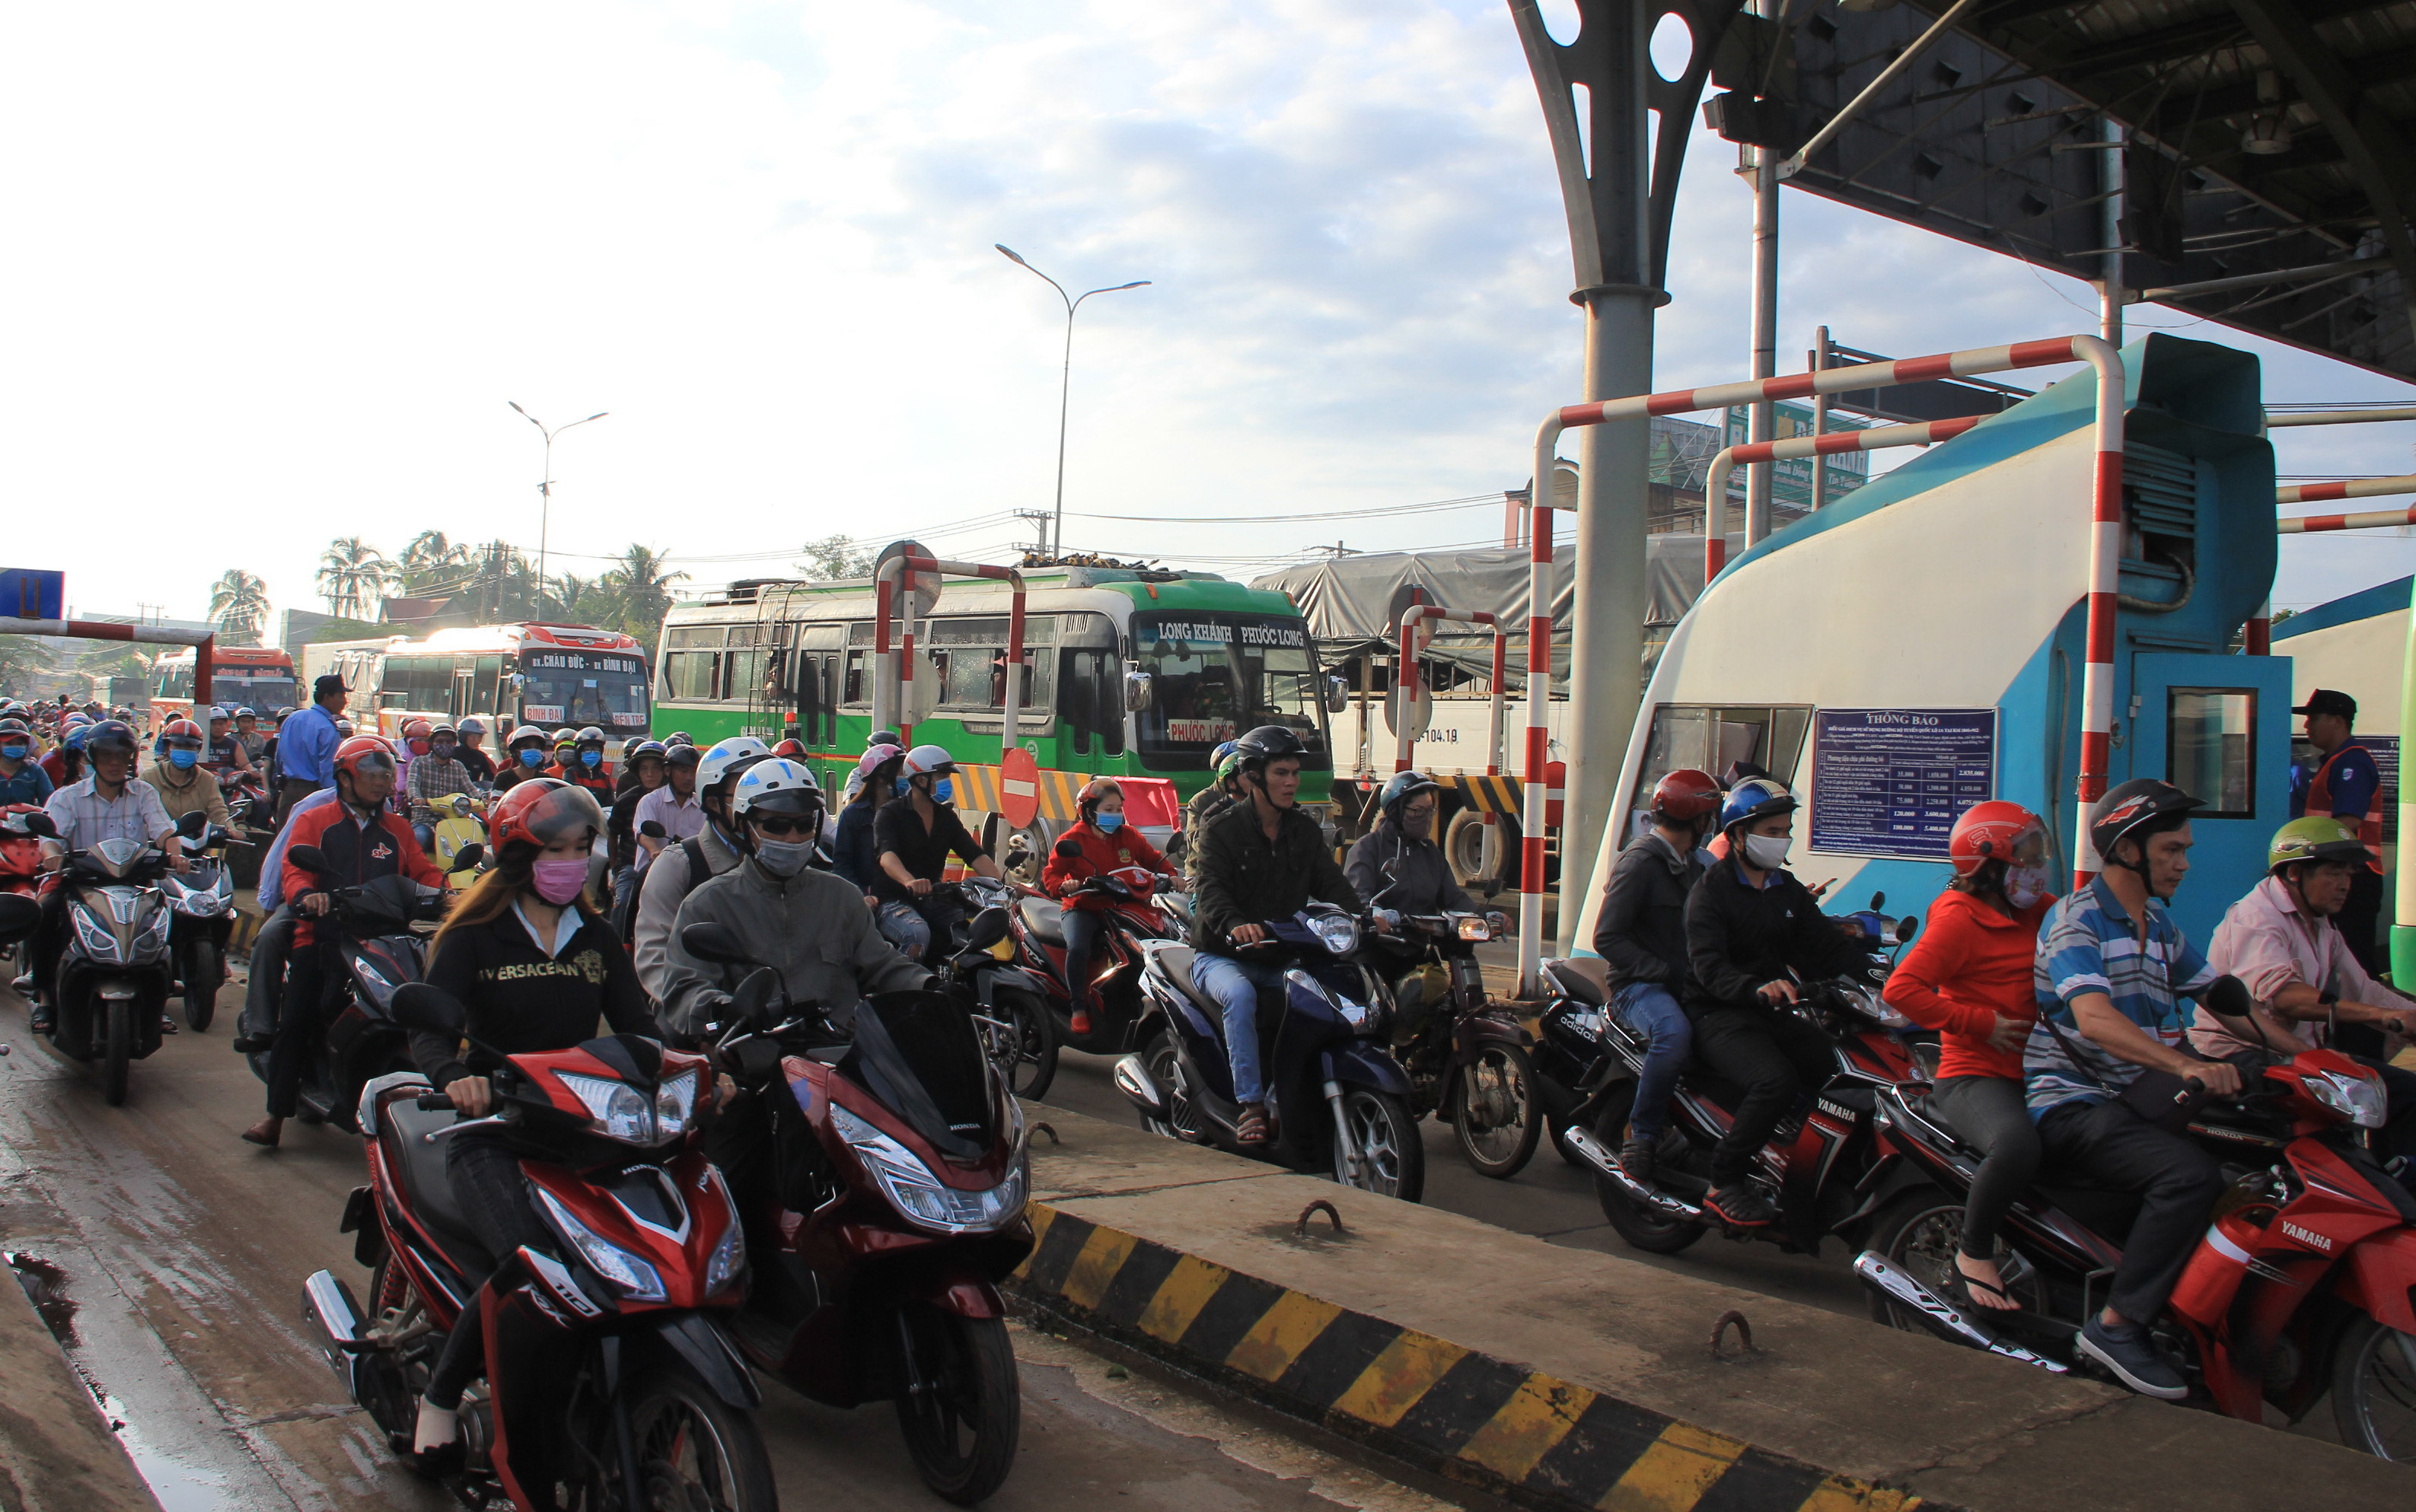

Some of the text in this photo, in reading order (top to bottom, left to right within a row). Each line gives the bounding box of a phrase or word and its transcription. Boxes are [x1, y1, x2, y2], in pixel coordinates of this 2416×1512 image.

[1159, 621, 1304, 647] LONG KHÁNH PHƯỚC LONG
[568, 653, 585, 669] ĐỨC
[594, 661, 601, 670] BX
[603, 657, 621, 672] BÌNH
[623, 660, 636, 674] ĐẠI
[528, 706, 563, 723] BÌNH ĐẠI
[1866, 711, 1939, 726] THÔNG BÁO
[1171, 721, 1236, 741] PHƯỚC LONG
[1560, 1016, 1597, 1042] adidas
[1818, 1097, 1856, 1122] YAMAHA
[2207, 1128, 2244, 1141] HONDA
[2282, 1220, 2332, 1251] YAMAHA
